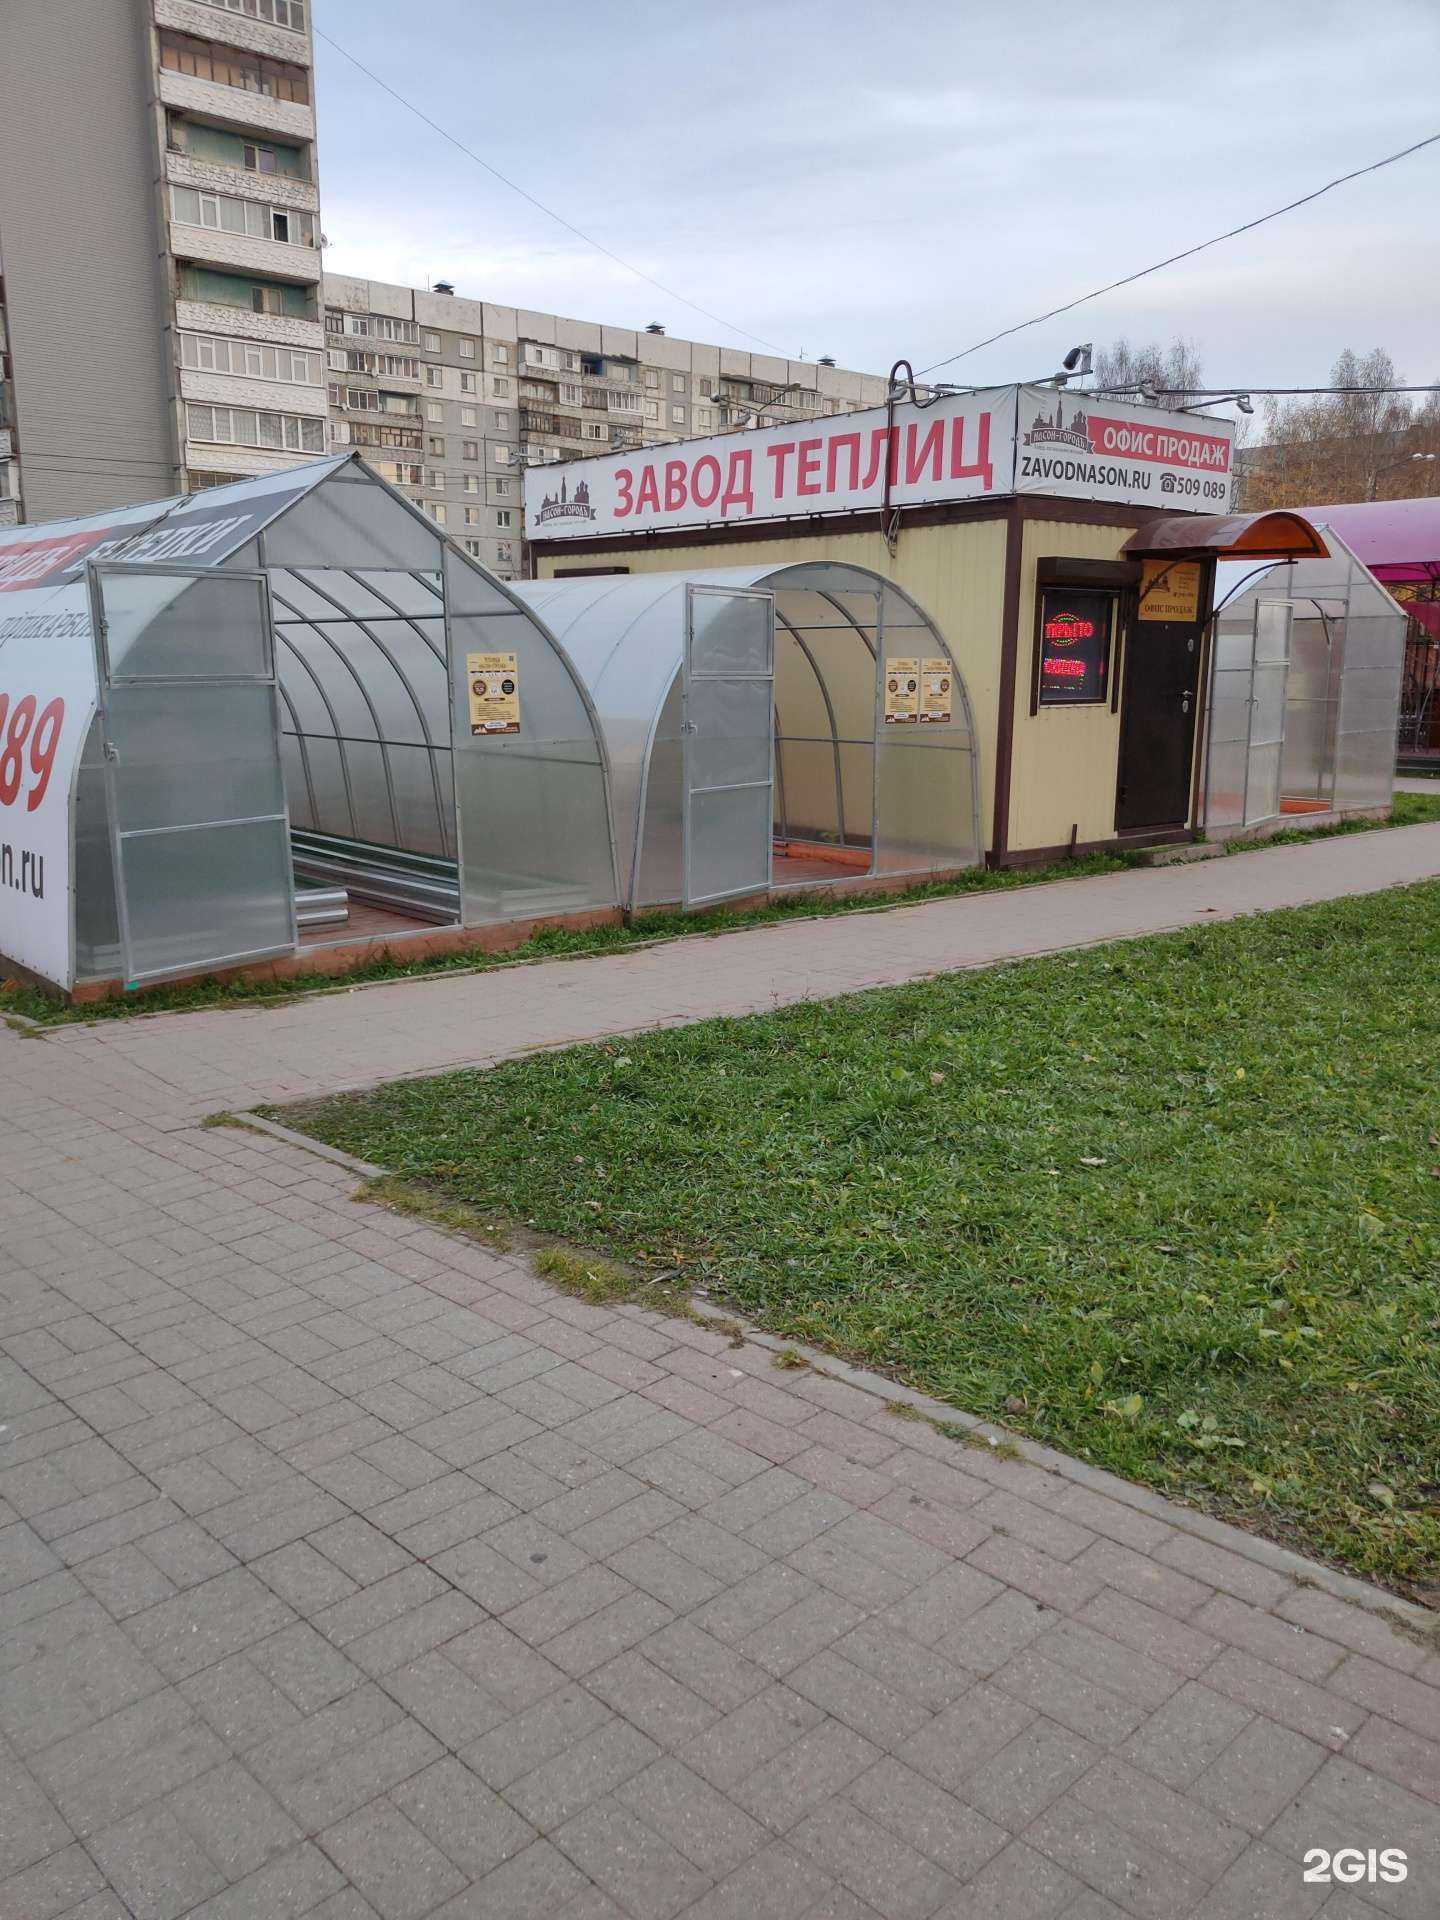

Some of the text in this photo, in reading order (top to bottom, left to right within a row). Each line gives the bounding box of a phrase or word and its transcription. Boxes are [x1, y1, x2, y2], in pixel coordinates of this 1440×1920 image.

[613, 412, 993, 518] ЗАВОД ТЕПЛИЦ
[1103, 426, 1225, 467] ОФИС ПРОДАЖ
[1021, 456, 1151, 490] ZAVODNASON.RU
[1176, 476, 1226, 499] 509 089
